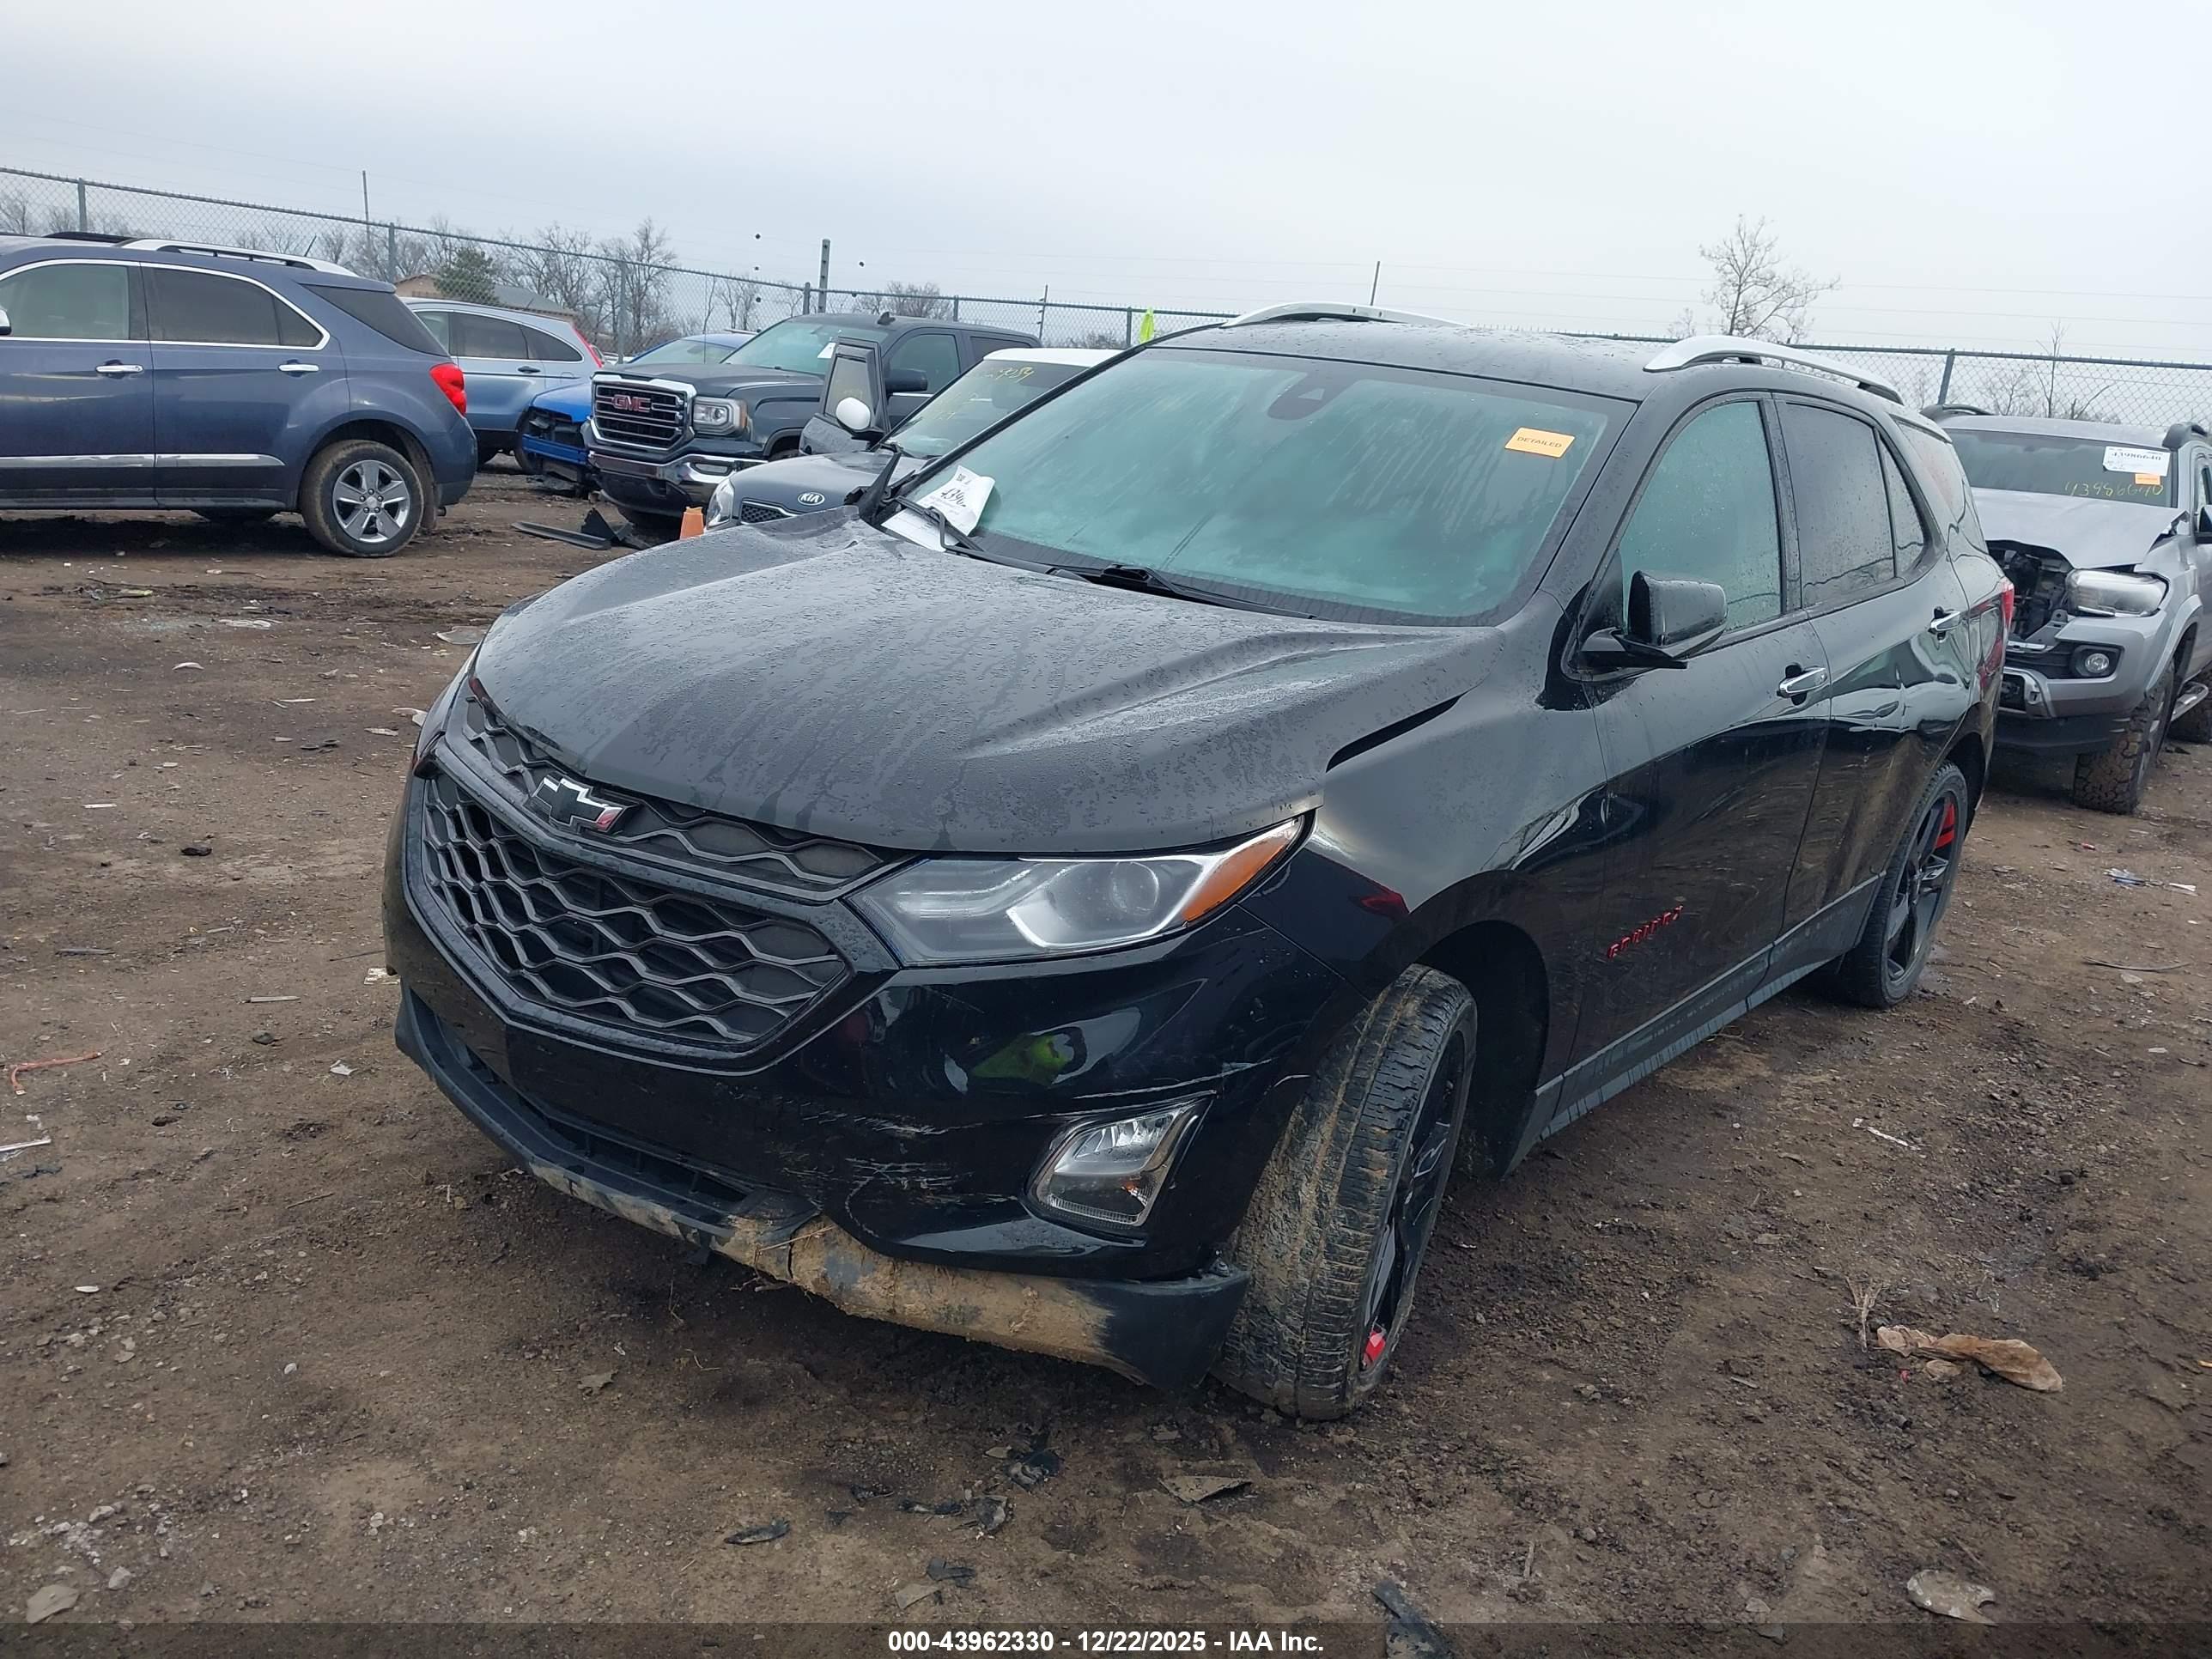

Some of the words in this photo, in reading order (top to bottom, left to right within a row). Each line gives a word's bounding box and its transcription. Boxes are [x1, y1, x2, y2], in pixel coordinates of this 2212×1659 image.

[613, 394, 651, 412] GMC
[1516, 437, 1562, 448] DETAILED
[799, 493, 820, 504] KIA
